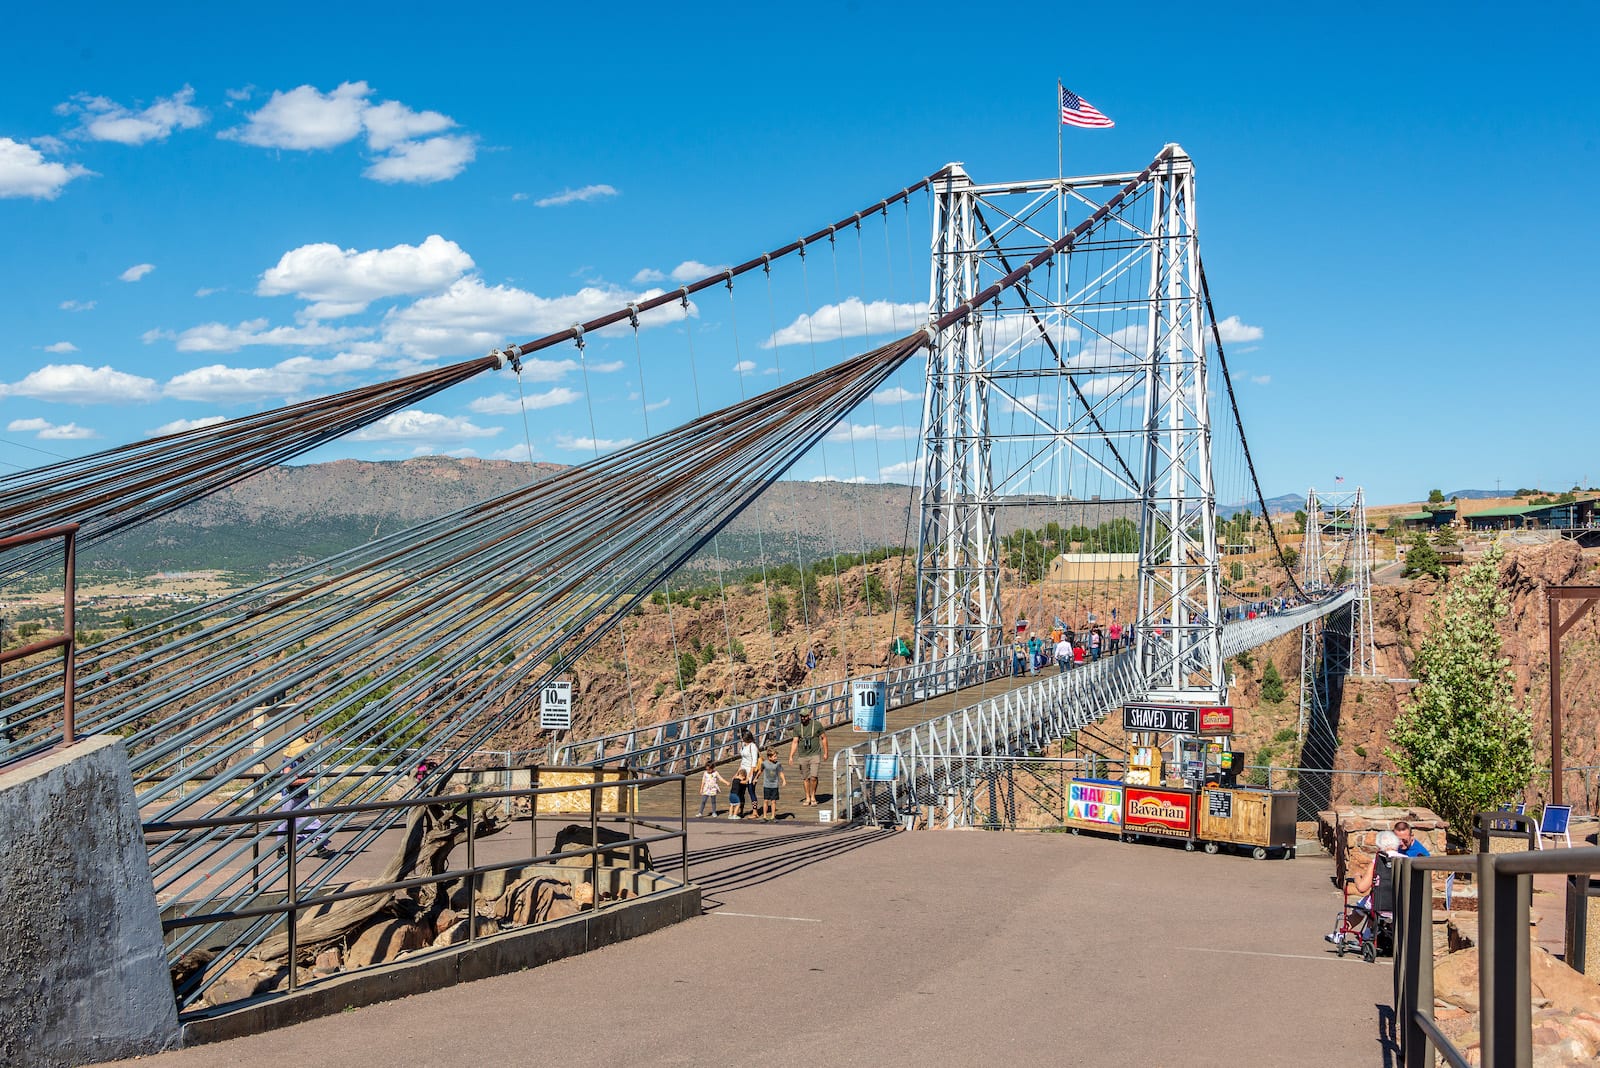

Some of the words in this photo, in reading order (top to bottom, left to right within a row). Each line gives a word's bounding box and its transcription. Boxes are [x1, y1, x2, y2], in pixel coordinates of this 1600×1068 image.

[545, 689, 558, 704] 10
[858, 690, 876, 707] 10
[1131, 709, 1166, 729] SHAVED
[1172, 711, 1189, 730] ICE
[1071, 785, 1120, 806] SHAVED
[1084, 803, 1105, 820] ICE
[1130, 800, 1185, 819] Bavarian
[1125, 824, 1148, 833] GOURMET
[1149, 827, 1162, 835] SOFT
[1162, 829, 1190, 838] PRETZELS
